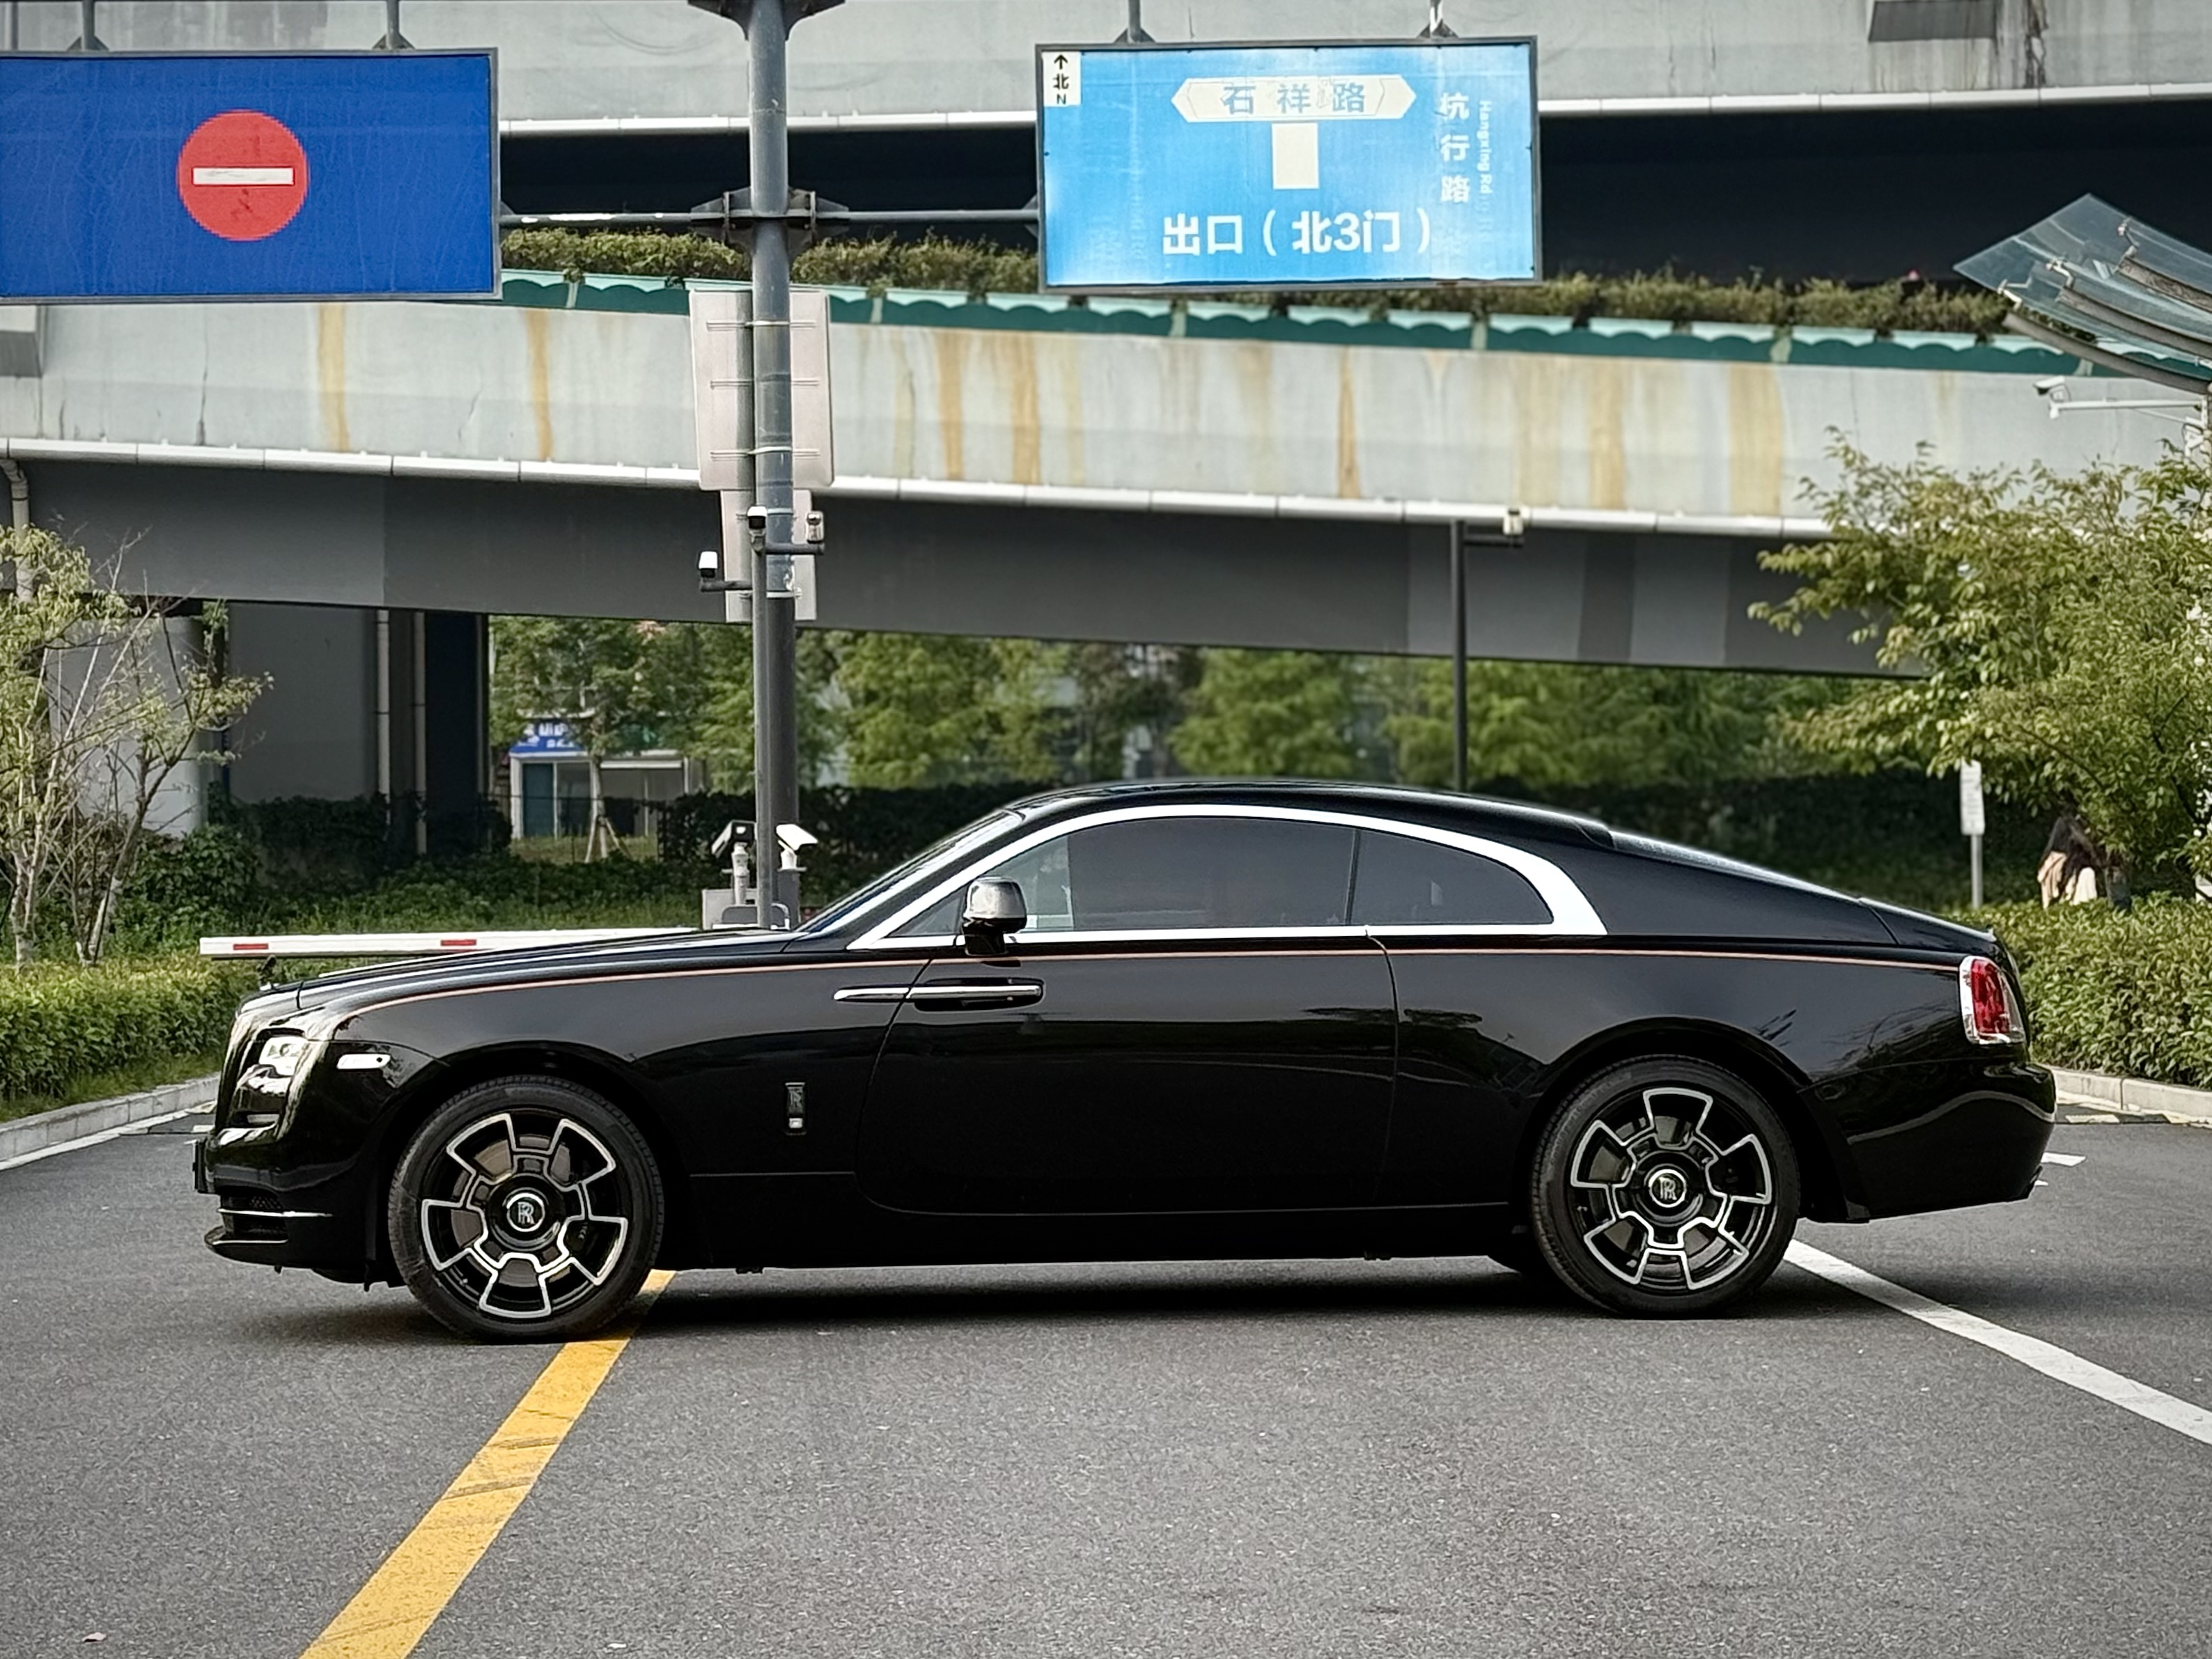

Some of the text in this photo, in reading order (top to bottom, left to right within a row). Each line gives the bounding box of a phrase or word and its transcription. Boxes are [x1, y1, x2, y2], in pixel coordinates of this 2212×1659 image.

[1052, 73, 1070, 91] 北
[1057, 93, 1066, 104] N
[1220, 82, 1366, 114] 石祥路
[1439, 92, 1470, 203] 杭行路
[1477, 100, 1493, 172] Hangxing
[1480, 173, 1493, 194] Rd
